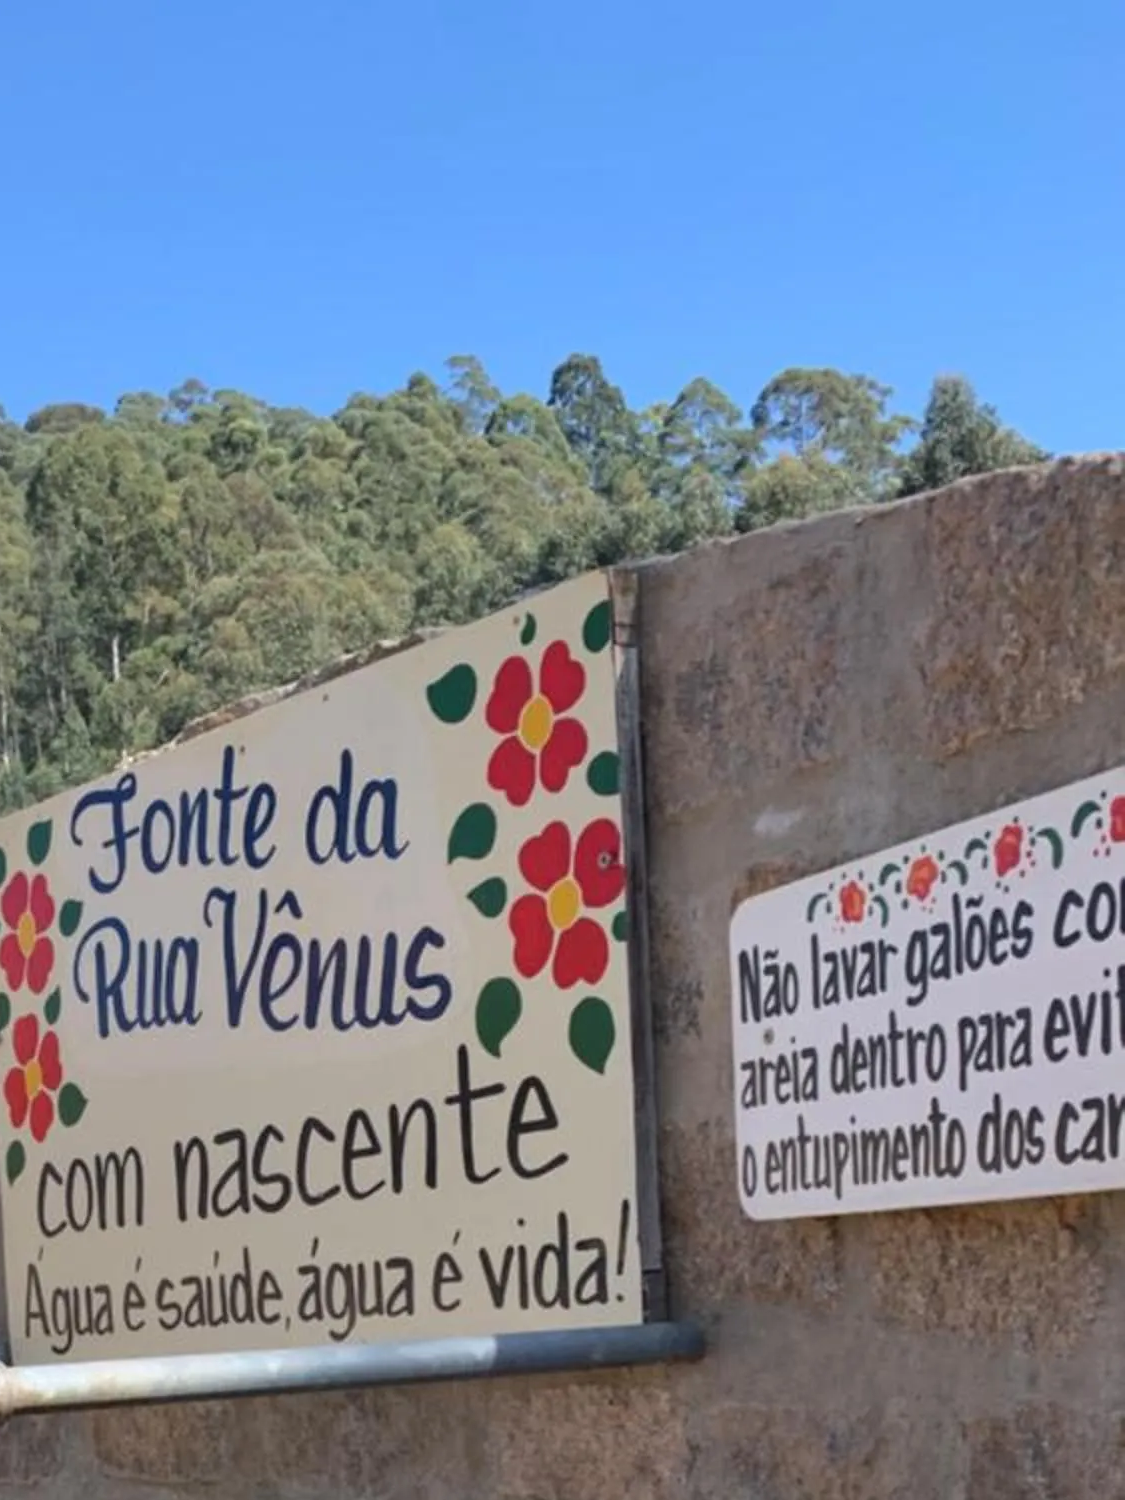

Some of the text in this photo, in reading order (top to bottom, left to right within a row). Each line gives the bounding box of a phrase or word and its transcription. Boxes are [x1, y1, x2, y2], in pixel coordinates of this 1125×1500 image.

[71, 744, 409, 894] Fonte da
[74, 887, 452, 1038] Rua Vênus
[738, 876, 1125, 1024] Não lavar galões co
[740, 1037, 818, 1109] areia
[830, 1009, 946, 1095] dentro
[959, 1006, 1032, 1092] para
[36, 1043, 569, 1238] com nascente
[742, 1143, 757, 1198] o
[764, 1096, 966, 1200] entupimento
[977, 1093, 1045, 1174] dos
[25, 1199, 631, 1354] Água é saúde, água é vida!
